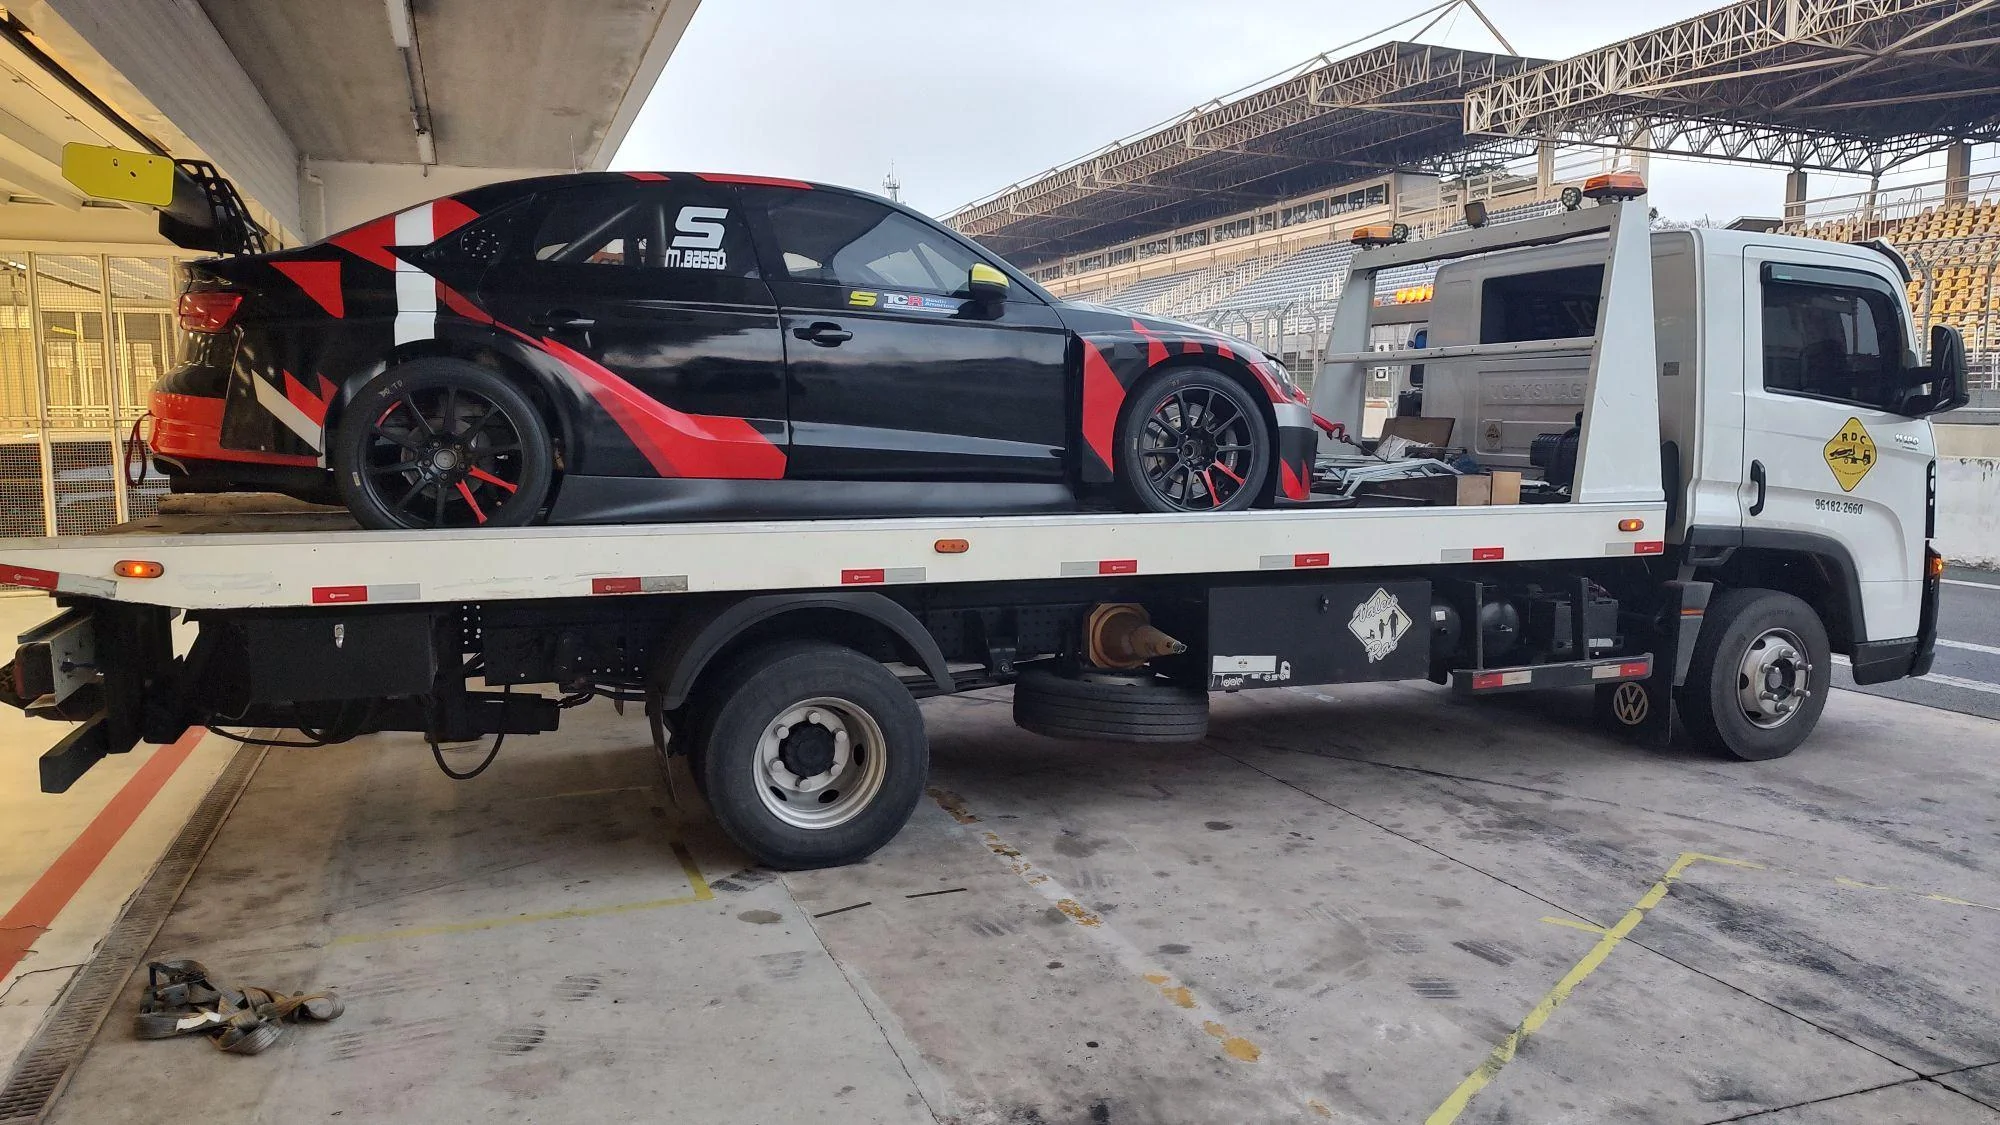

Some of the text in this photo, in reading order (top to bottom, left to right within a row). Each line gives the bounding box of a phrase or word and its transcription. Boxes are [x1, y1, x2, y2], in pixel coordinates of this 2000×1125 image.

[671, 206, 729, 249] S
[849, 291, 878, 306] S
[884, 293, 924, 306] TCR
[1488, 383, 1588, 400] VOLKSWAG
[1815, 498, 1863, 515] 96182-2660
